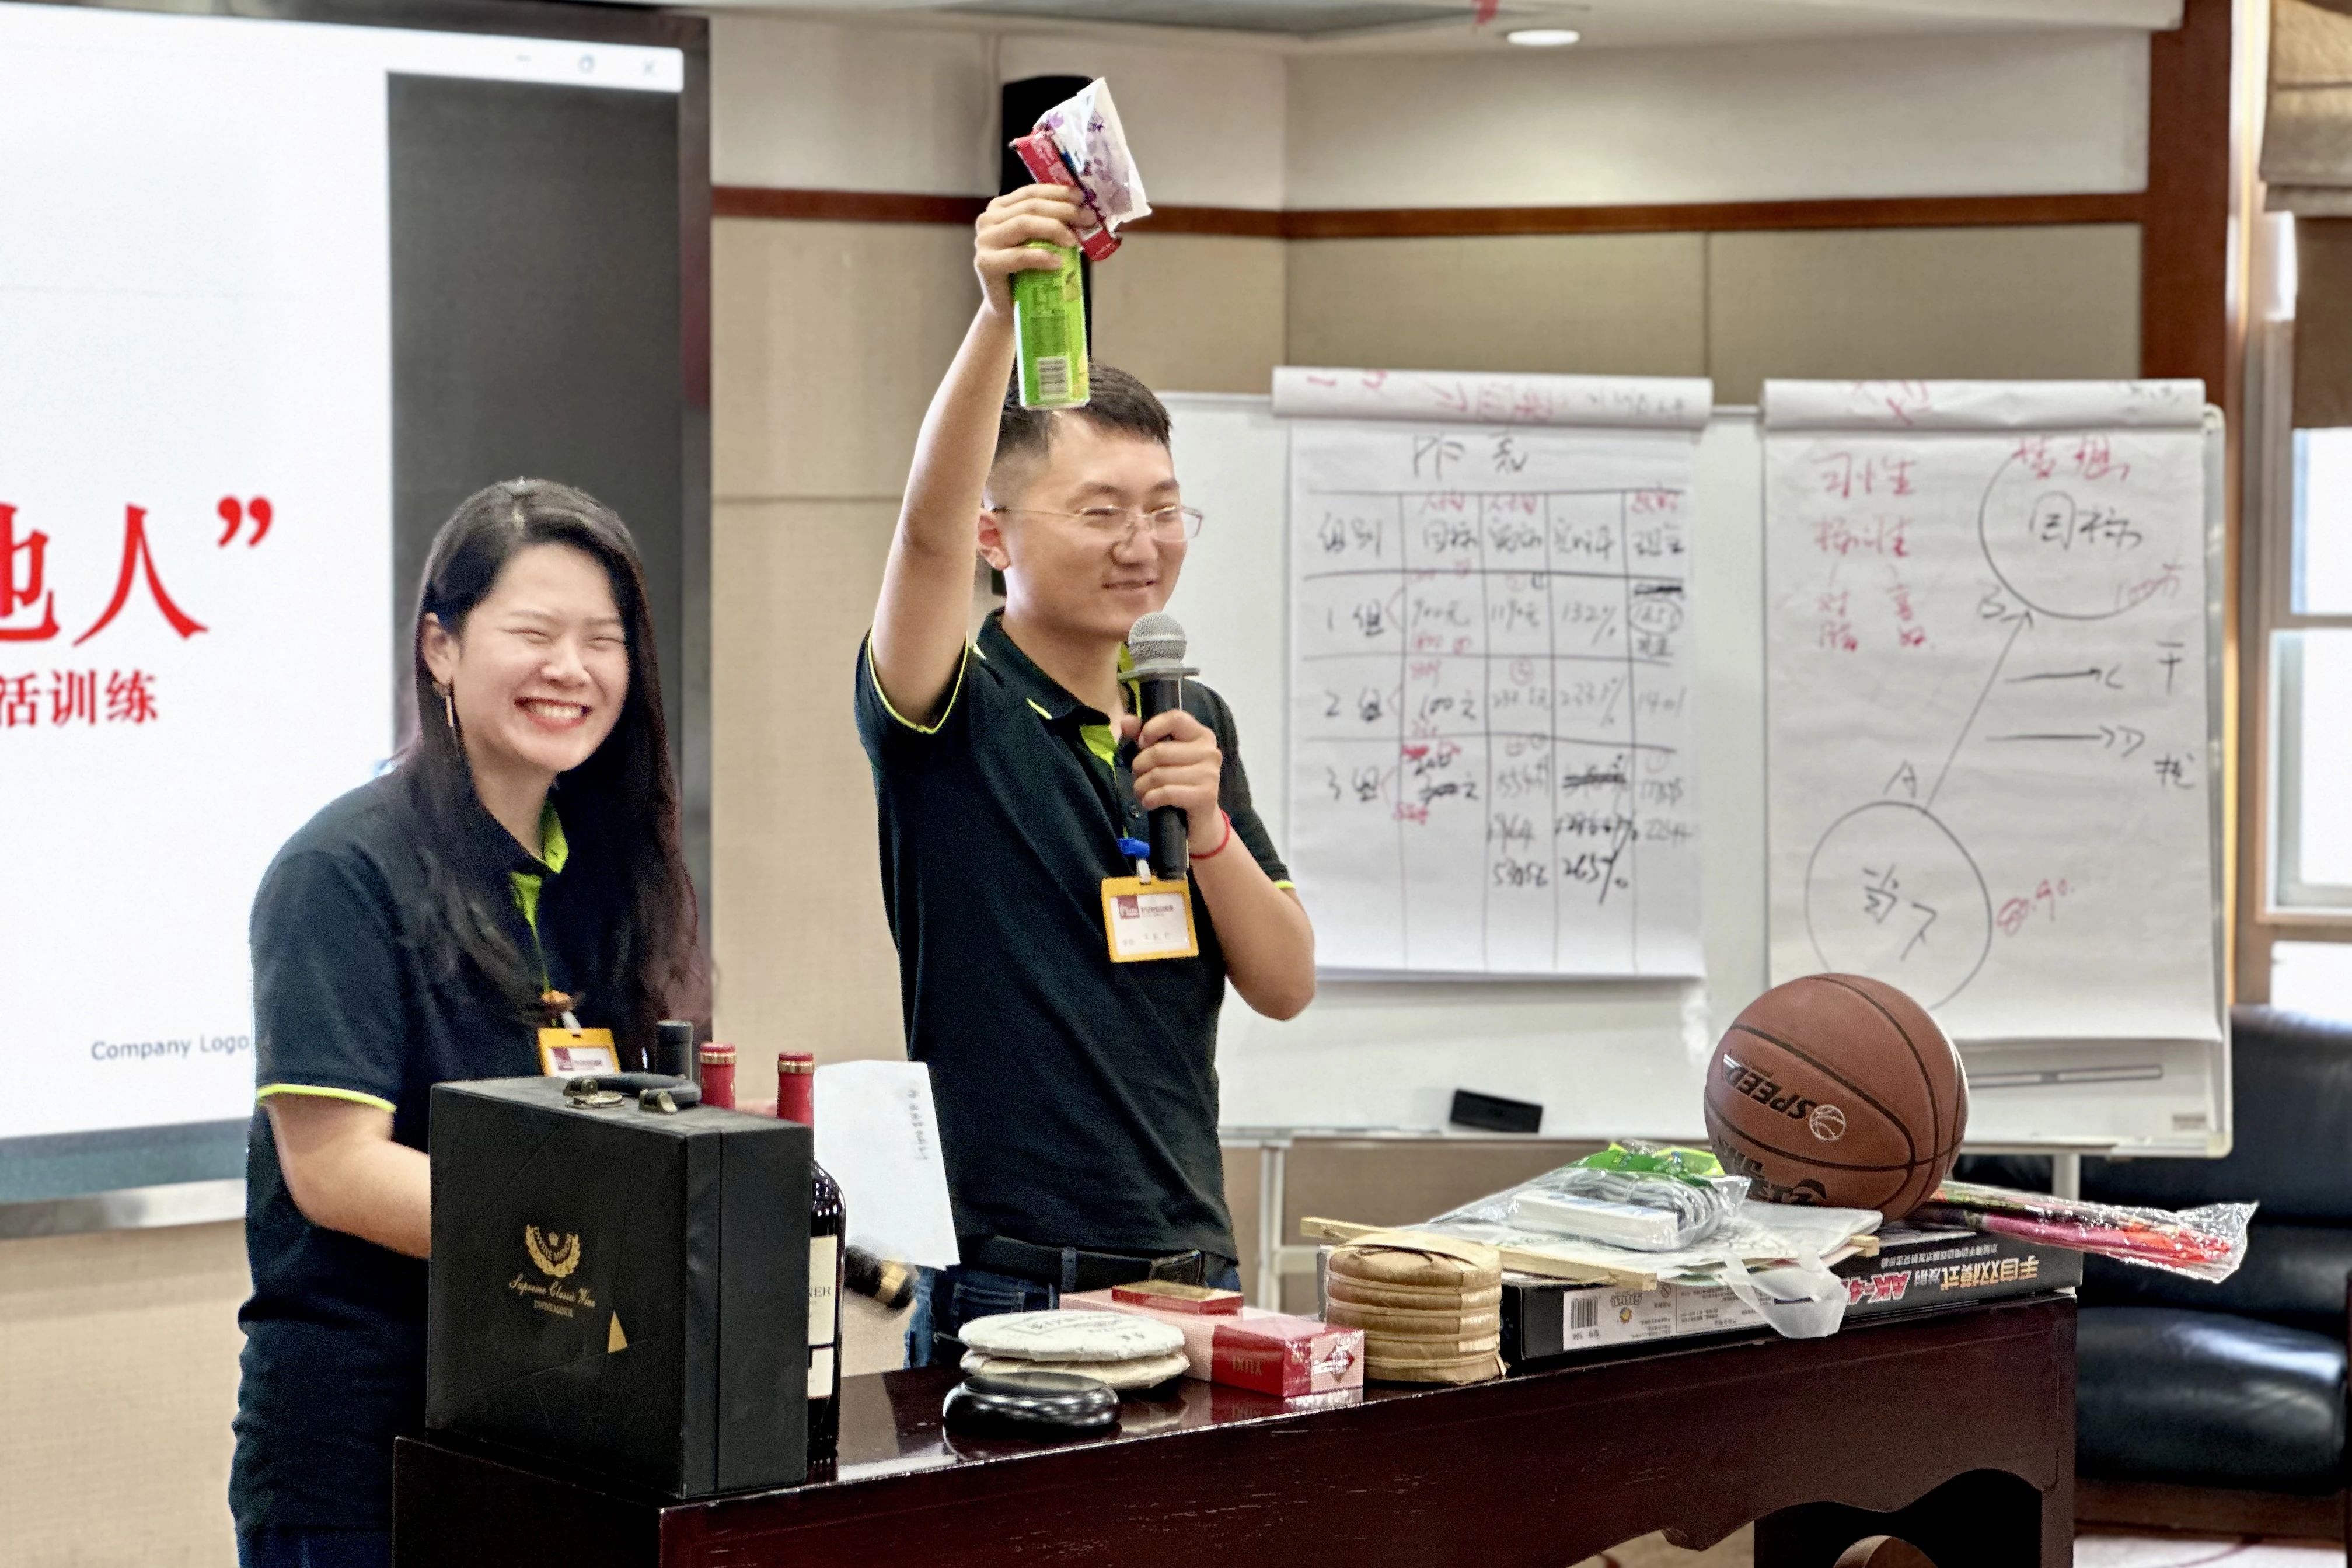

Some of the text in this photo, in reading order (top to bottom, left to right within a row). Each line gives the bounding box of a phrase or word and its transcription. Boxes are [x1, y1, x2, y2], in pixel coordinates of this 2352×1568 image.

[2029, 490, 2143, 551] 目标
[0, 669, 158, 728] 活训练
[1883, 760, 1918, 799] A
[90, 1034, 250, 1061] Company Logo
[1723, 1054, 1817, 1120] SPEED
[1840, 1270, 1912, 1305] AK-4
[1232, 1355, 1262, 1377] YUXI
